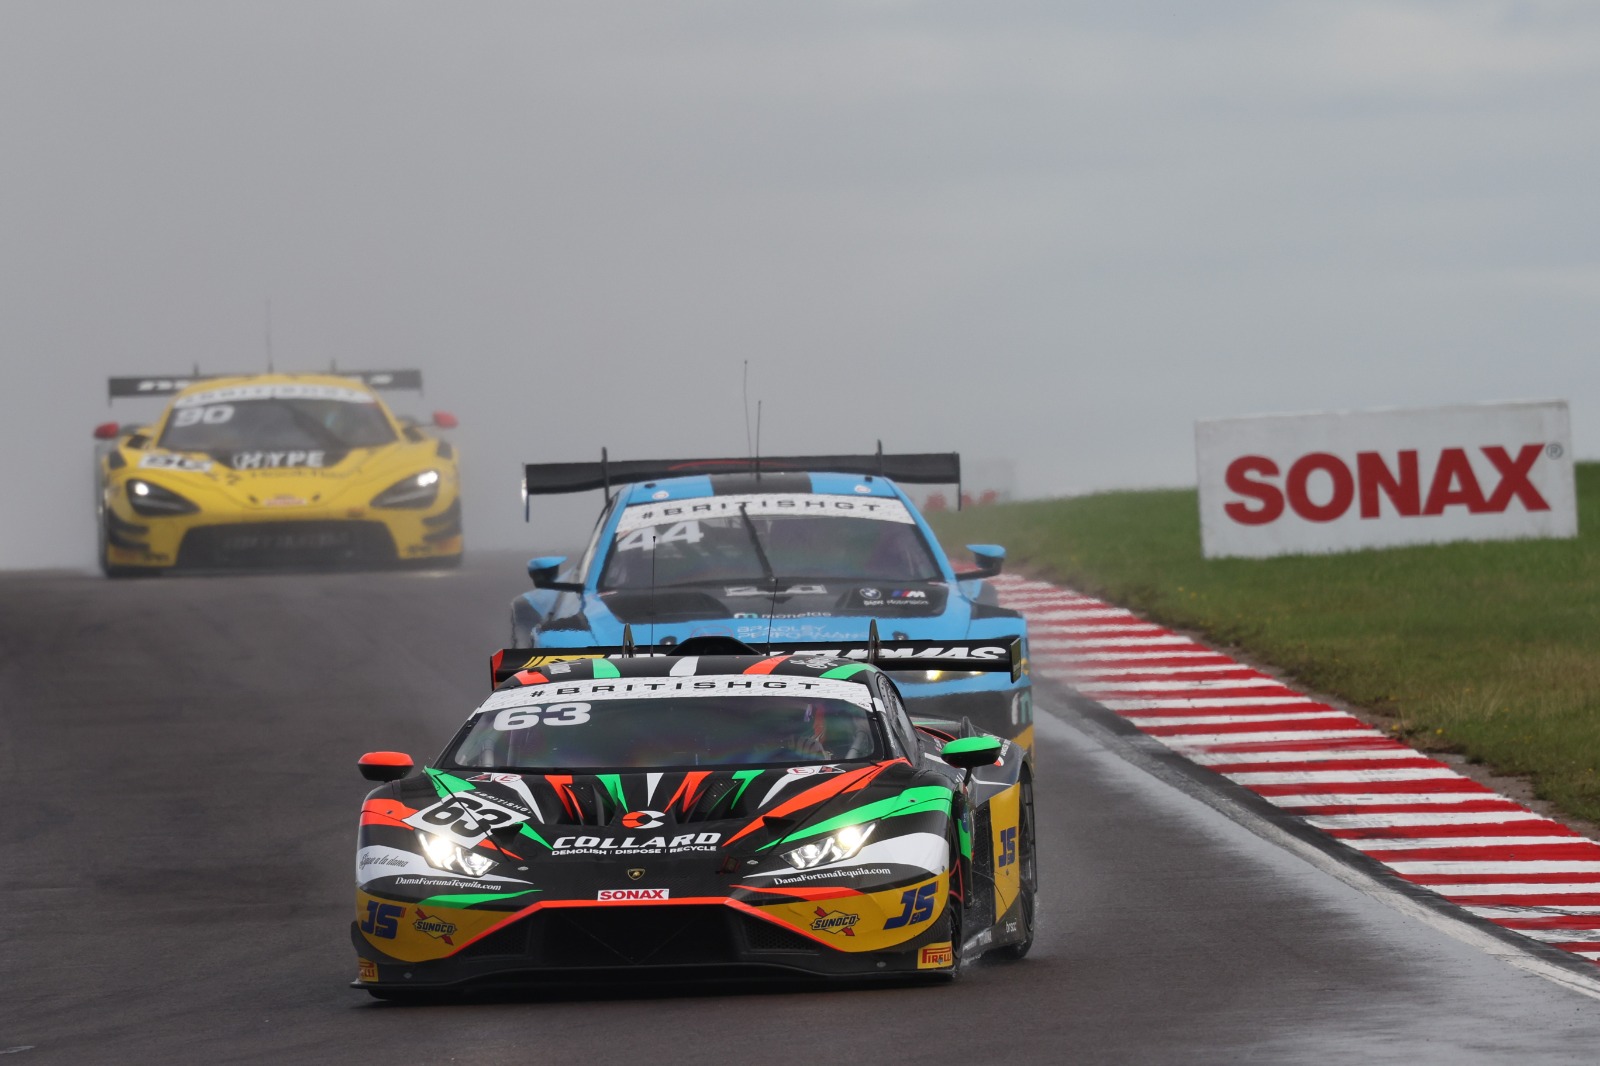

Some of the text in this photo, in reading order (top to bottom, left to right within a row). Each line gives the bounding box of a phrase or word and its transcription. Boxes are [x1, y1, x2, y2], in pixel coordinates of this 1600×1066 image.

[174, 405, 234, 427] 90
[1224, 443, 1552, 526] SONAX
[641, 500, 881, 519] #BRITISHGT
[618, 520, 704, 552] 44
[530, 680, 820, 698] #BRITISHGT
[493, 702, 592, 731] 63
[421, 797, 512, 838] 63
[552, 832, 722, 849] COLLARD
[552, 848, 607, 856] DEMOLISH
[669, 845, 717, 853] RECYCLE
[395, 876, 501, 891] DamaFortunaTequila.com
[773, 866, 891, 885] DamaFortunaTequila.com
[600, 889, 665, 900] SONAX
[416, 920, 454, 933] SUNOCO
[813, 915, 857, 929] SUNOCO
